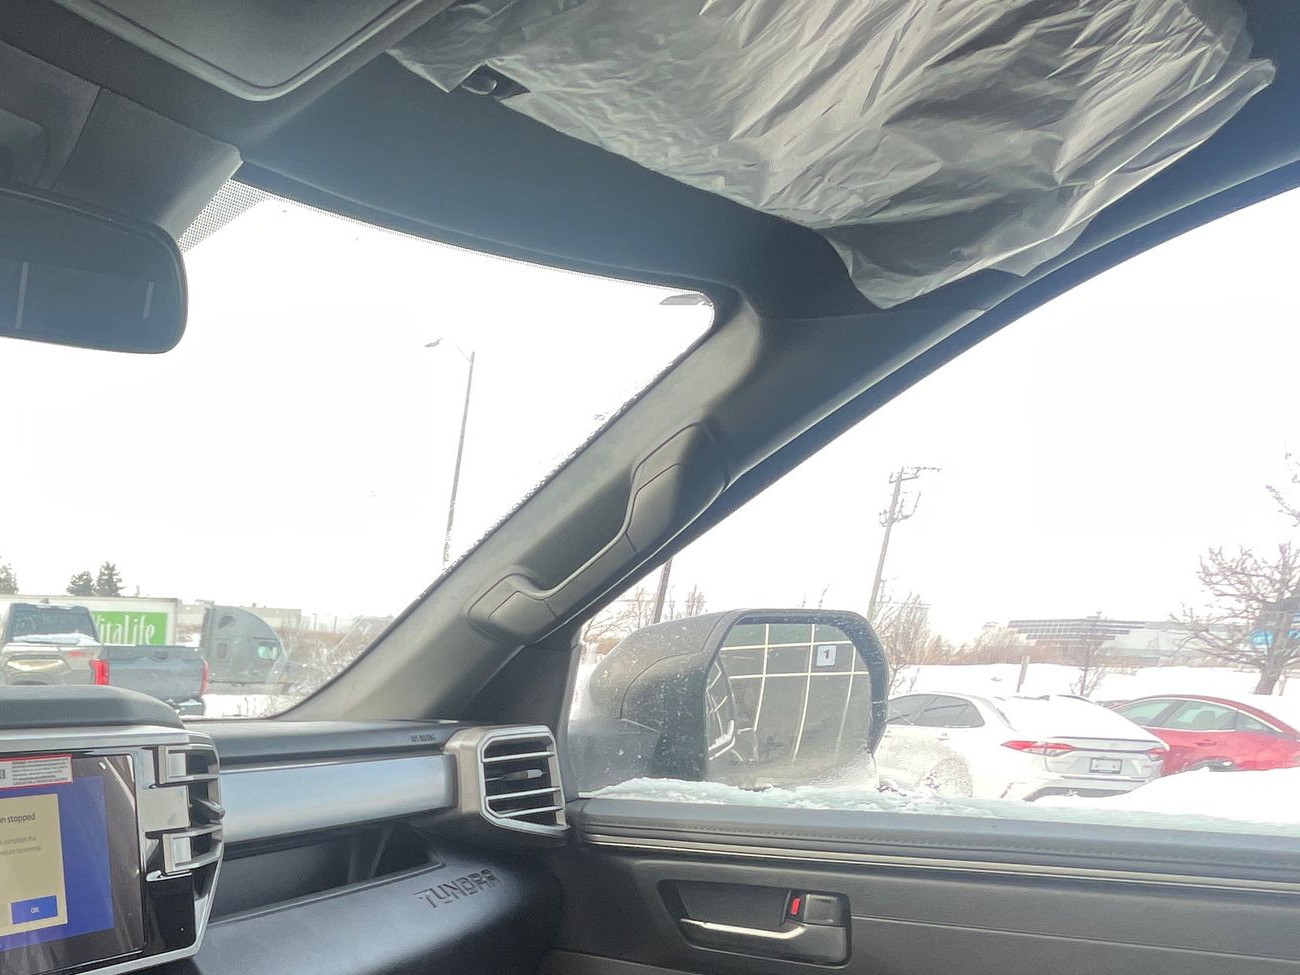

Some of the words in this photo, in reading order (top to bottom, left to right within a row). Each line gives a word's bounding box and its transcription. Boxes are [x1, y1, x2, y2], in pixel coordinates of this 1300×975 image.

[7, 812, 36, 824] stopped
[413, 868, 501, 909] TUNDRA
[30, 906, 40, 914] OK
